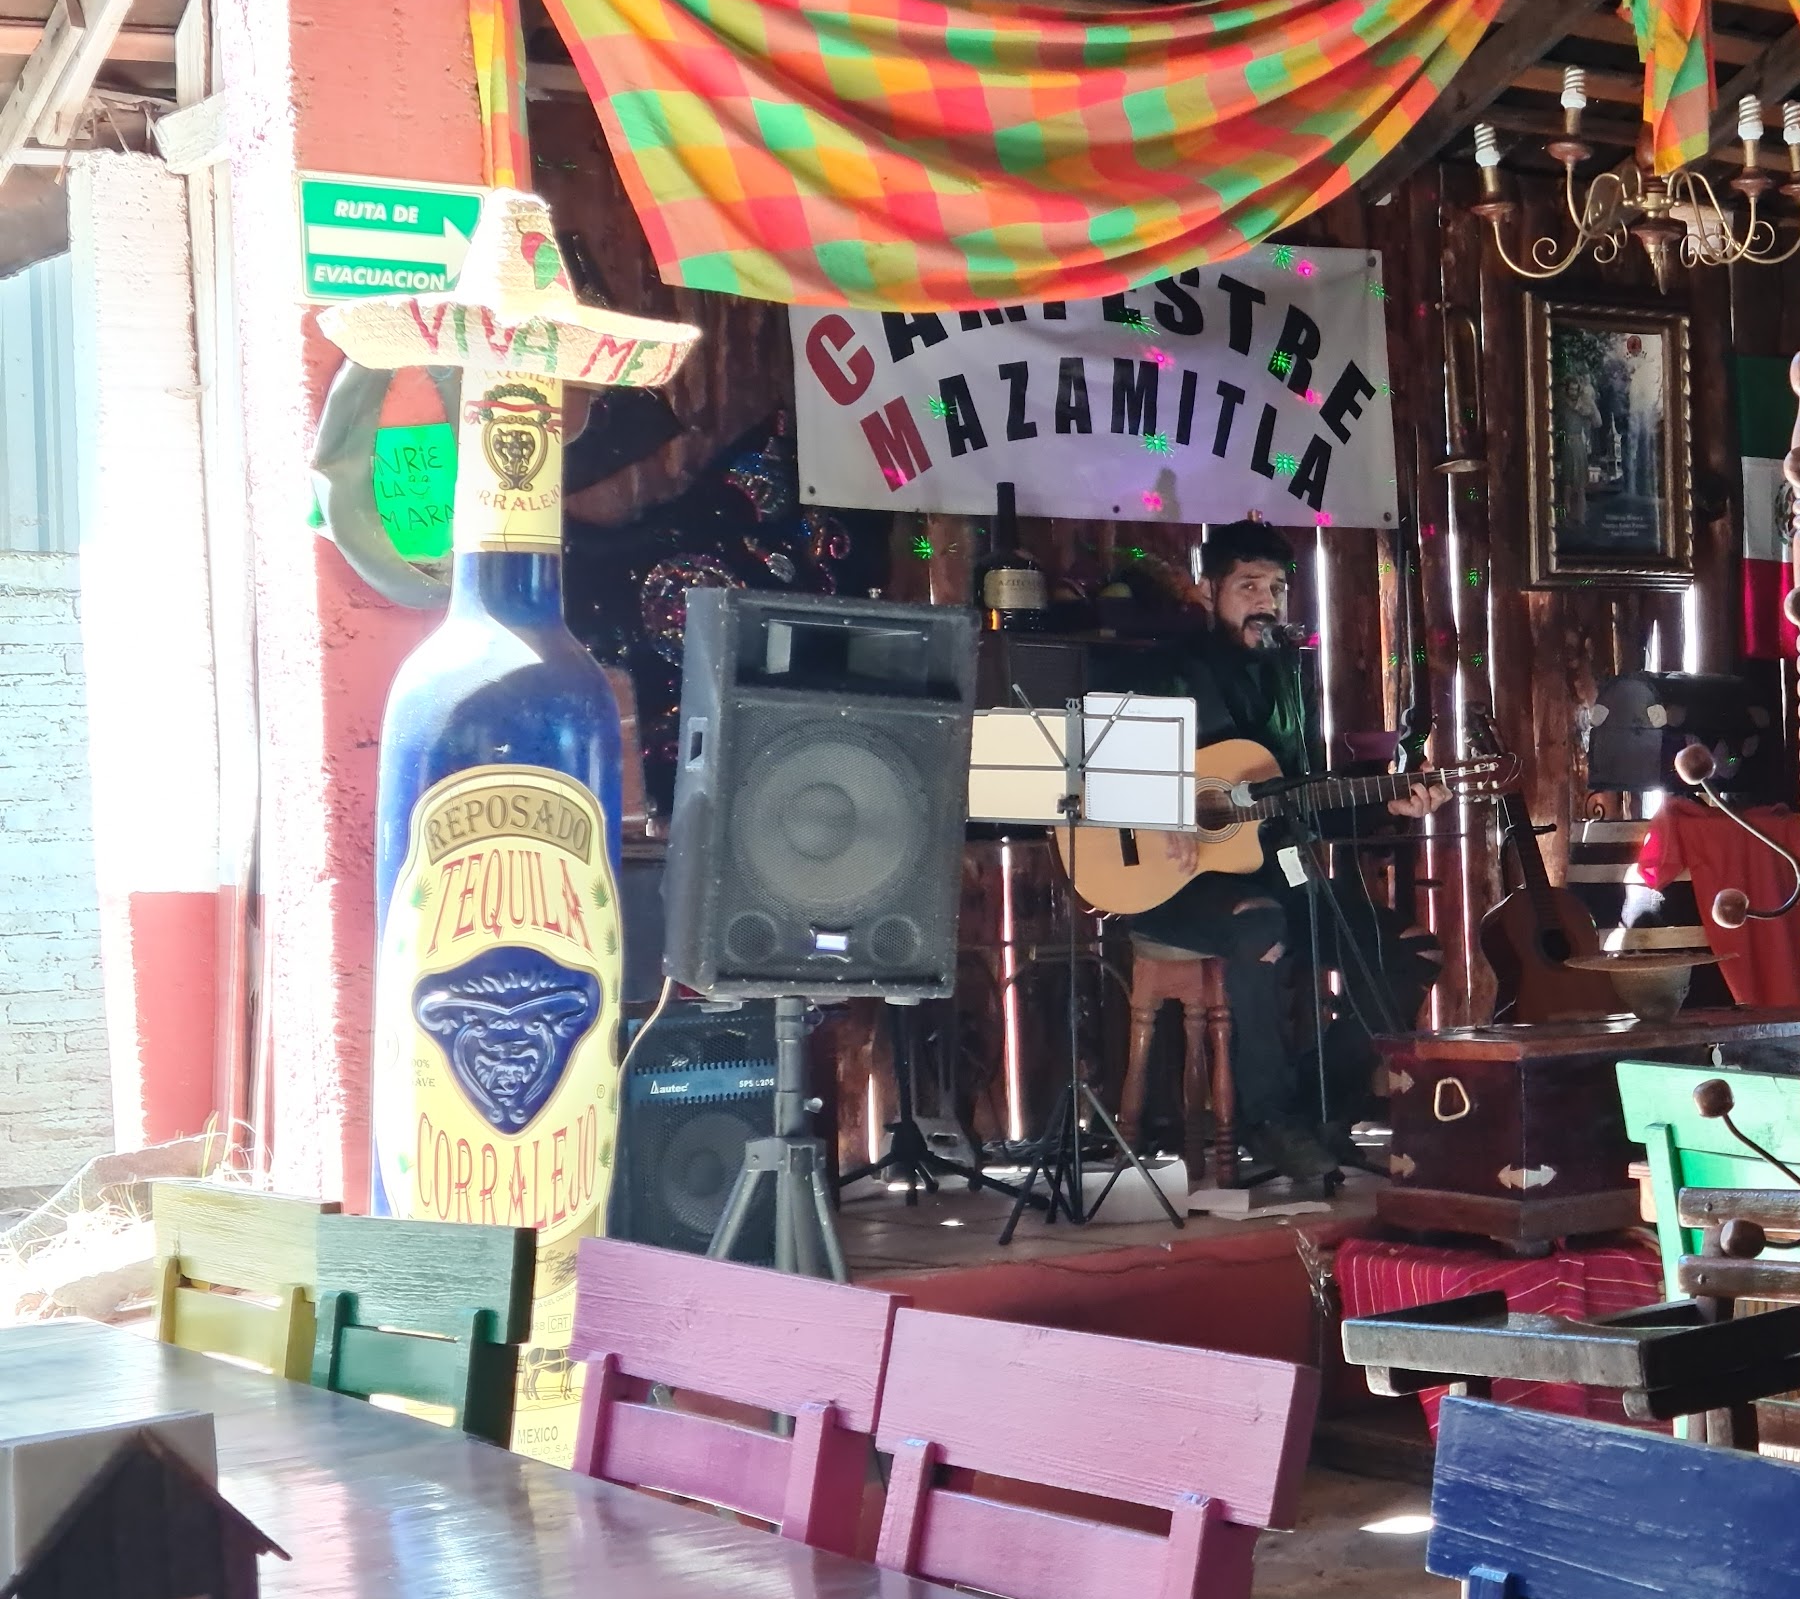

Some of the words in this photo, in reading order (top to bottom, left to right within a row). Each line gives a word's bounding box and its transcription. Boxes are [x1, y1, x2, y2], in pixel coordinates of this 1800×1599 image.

[334, 199, 387, 222] RUTA
[392, 204, 420, 224] DE
[313, 263, 446, 291] EVACUACION
[409, 297, 559, 373] VIVA
[804, 267, 1376, 444] CASTRE
[860, 357, 1333, 512] MAZAMITLA
[426, 794, 589, 851] REPOSADO
[426, 848, 595, 958] TEQUILA
[657, 1081, 689, 1094] autec
[739, 1080, 754, 1088] SPS
[417, 1103, 597, 1229] CORRALEJO
[551, 1317, 569, 1331] CRT
[517, 1425, 559, 1445] MEXICO
